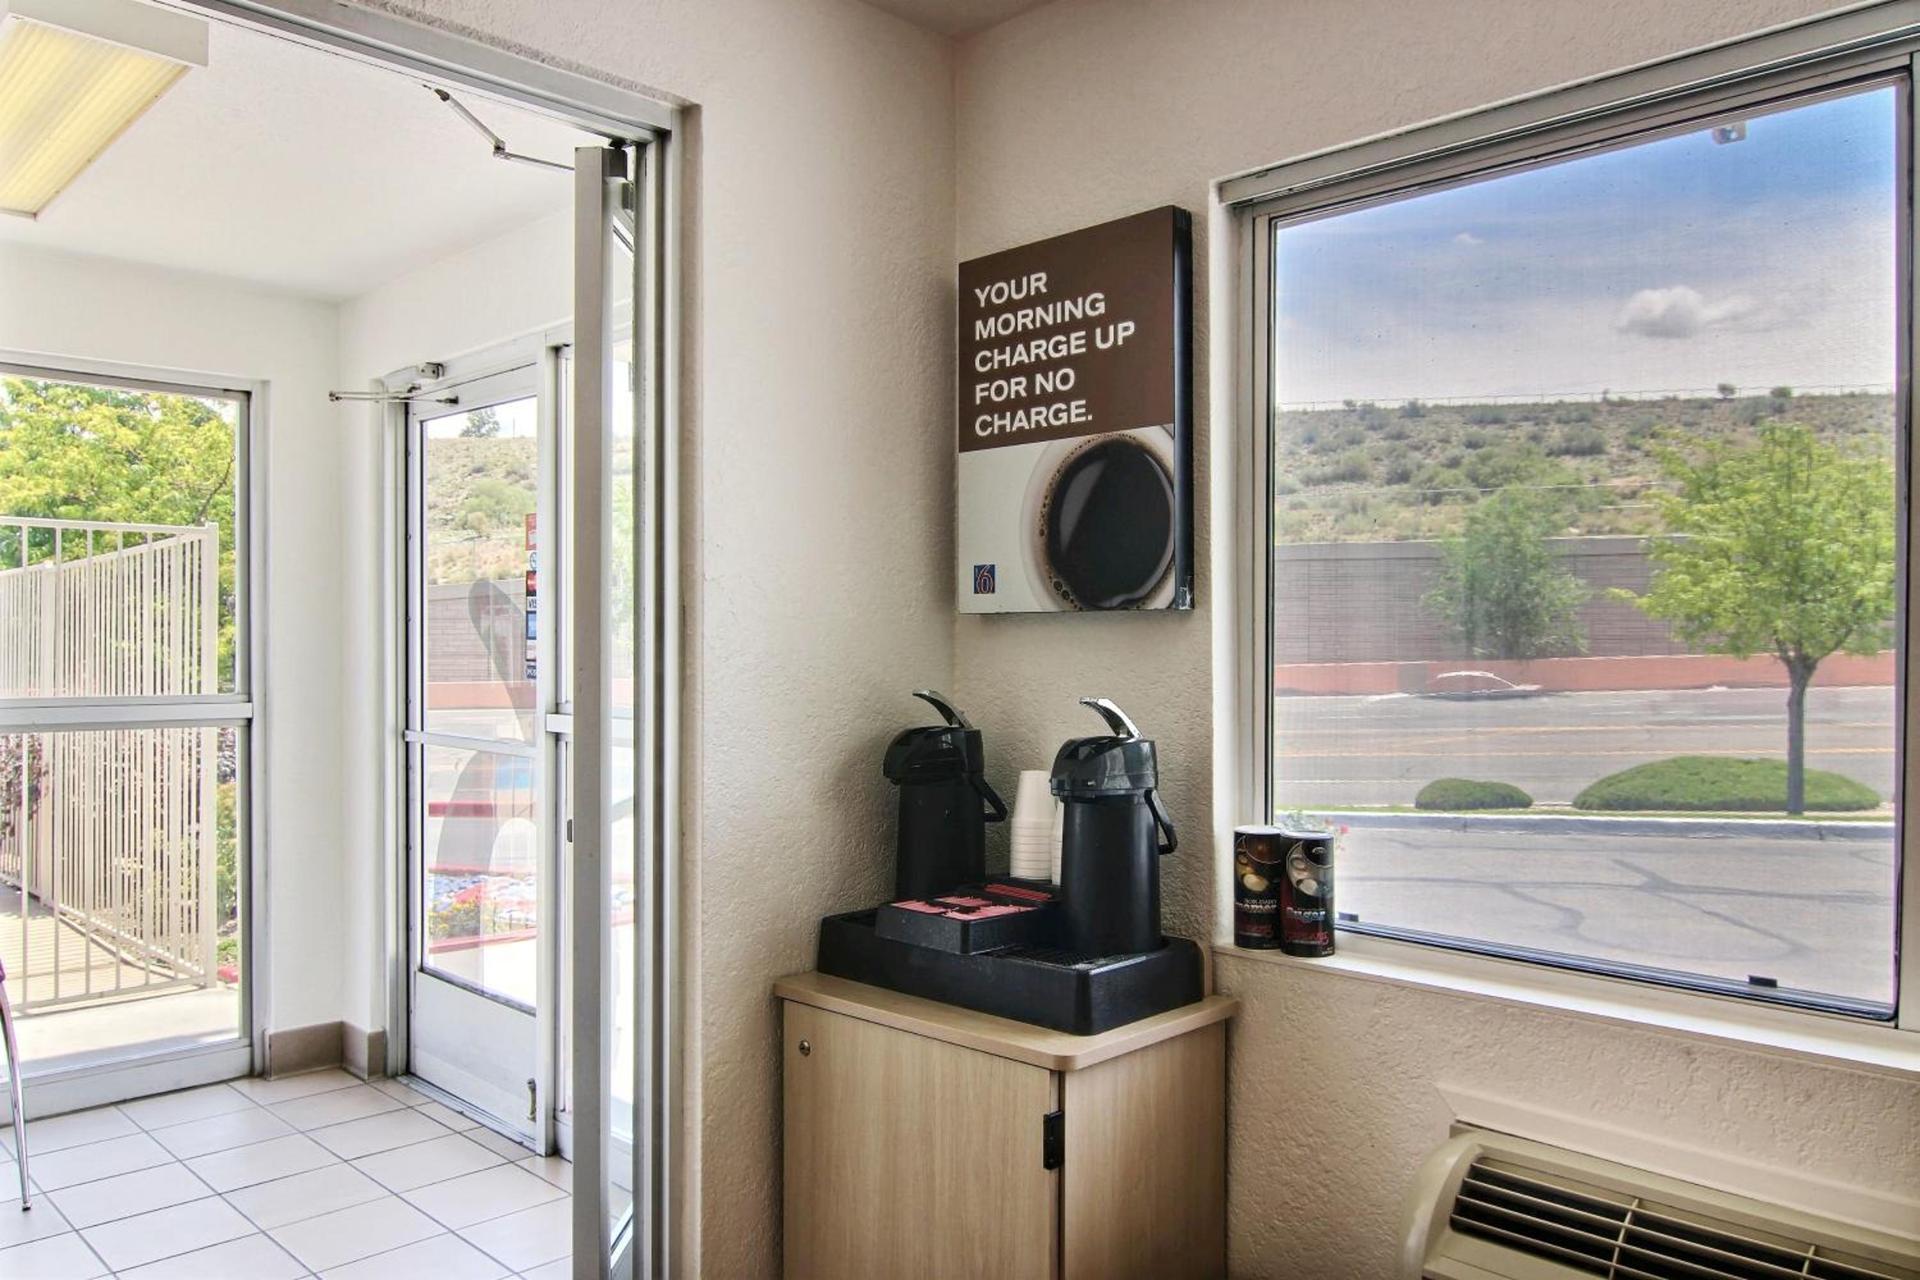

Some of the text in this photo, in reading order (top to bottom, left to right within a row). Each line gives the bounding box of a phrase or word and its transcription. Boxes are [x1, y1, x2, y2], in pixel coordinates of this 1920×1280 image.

[974, 272, 1047, 308] YOUR
[975, 292, 1105, 341] MORNING
[974, 321, 1135, 372] CHARGE UP
[975, 368, 1075, 405] FOR NO
[974, 400, 1092, 437] CHARGE.
[976, 565, 993, 593] 6
